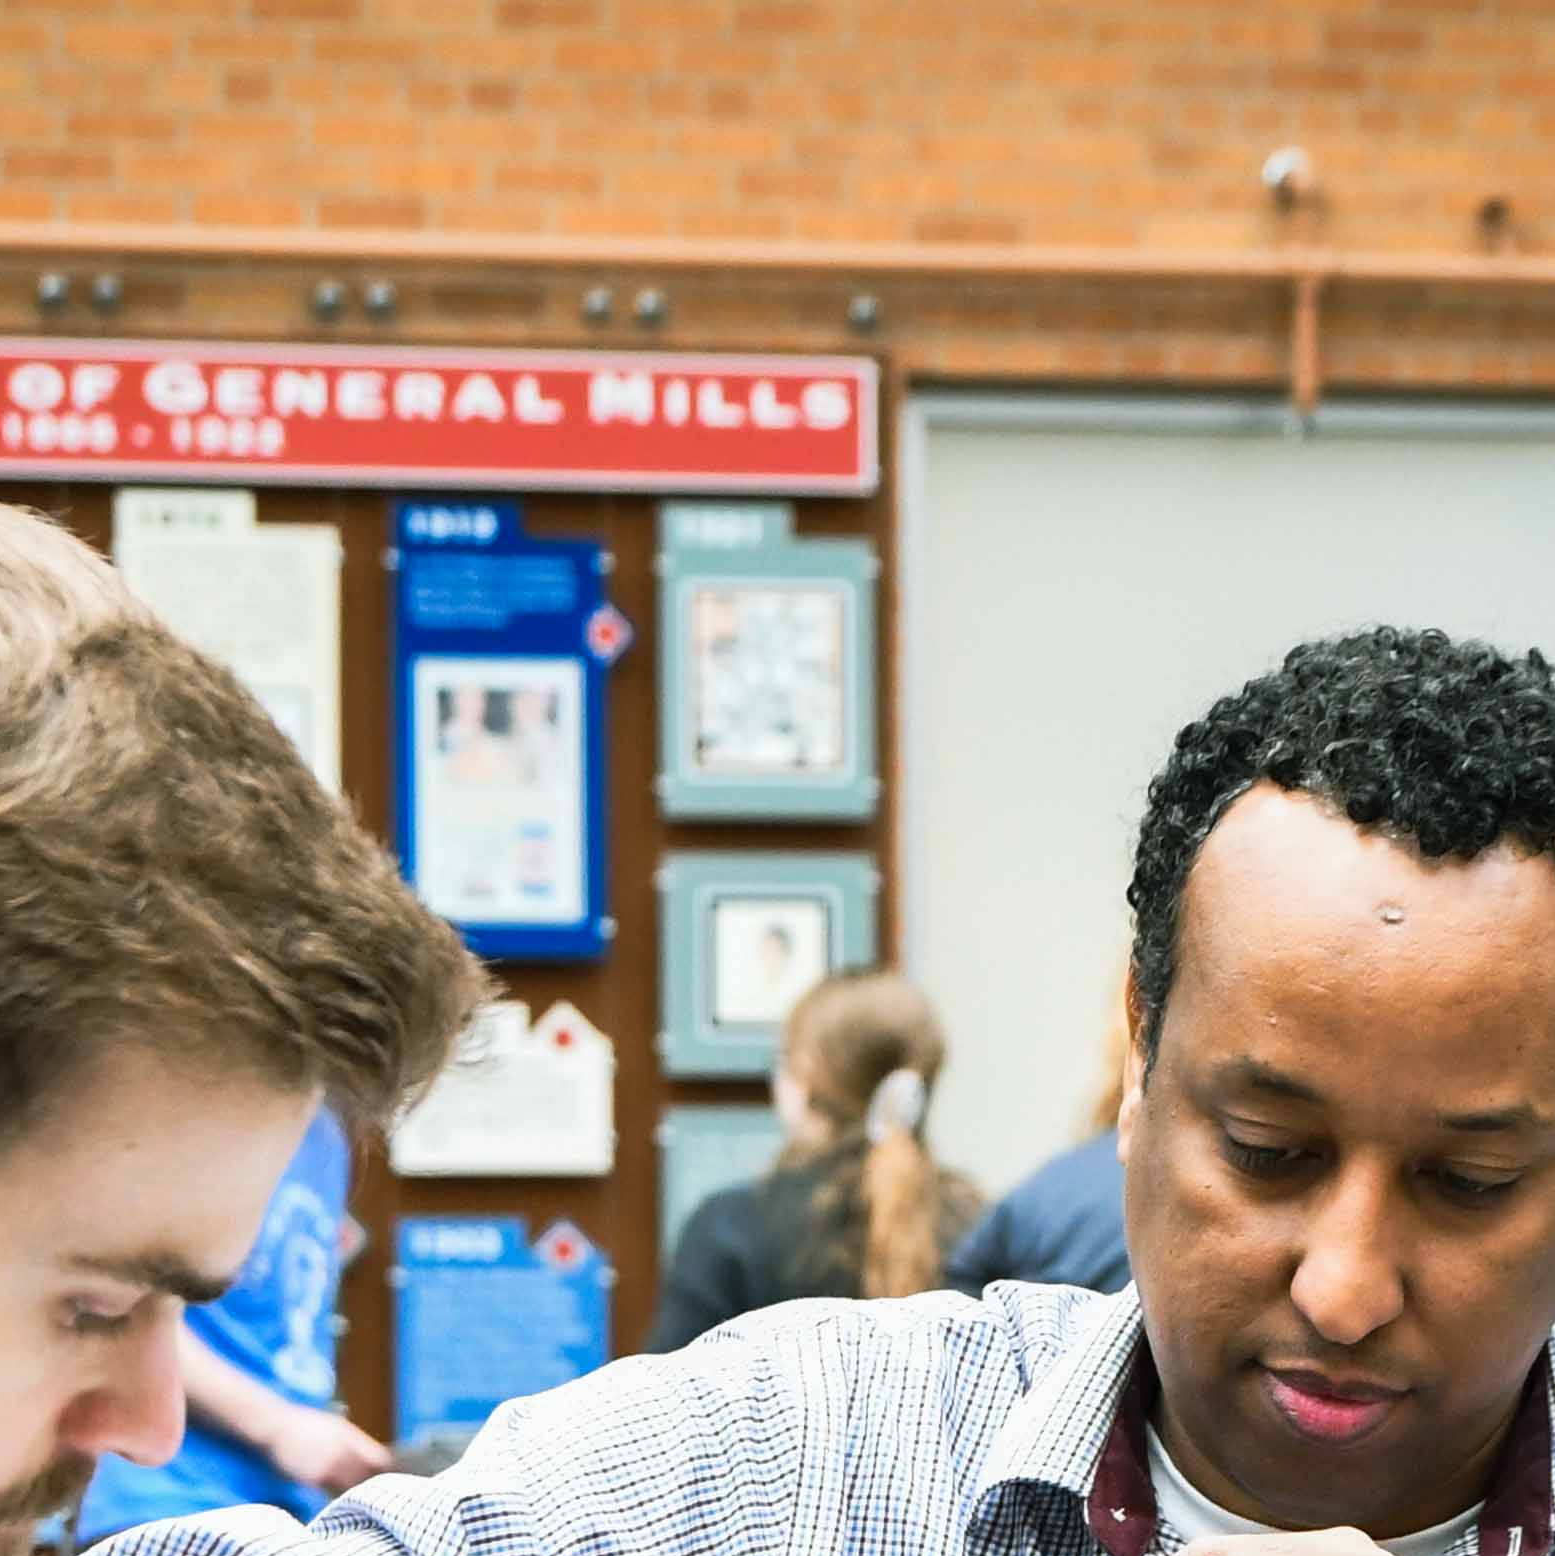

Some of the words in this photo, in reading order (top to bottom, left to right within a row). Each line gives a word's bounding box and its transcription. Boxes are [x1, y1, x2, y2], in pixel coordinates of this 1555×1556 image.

[8, 361, 120, 410] OF
[144, 359, 563, 424] GENERAL
[588, 369, 853, 430] MILLS
